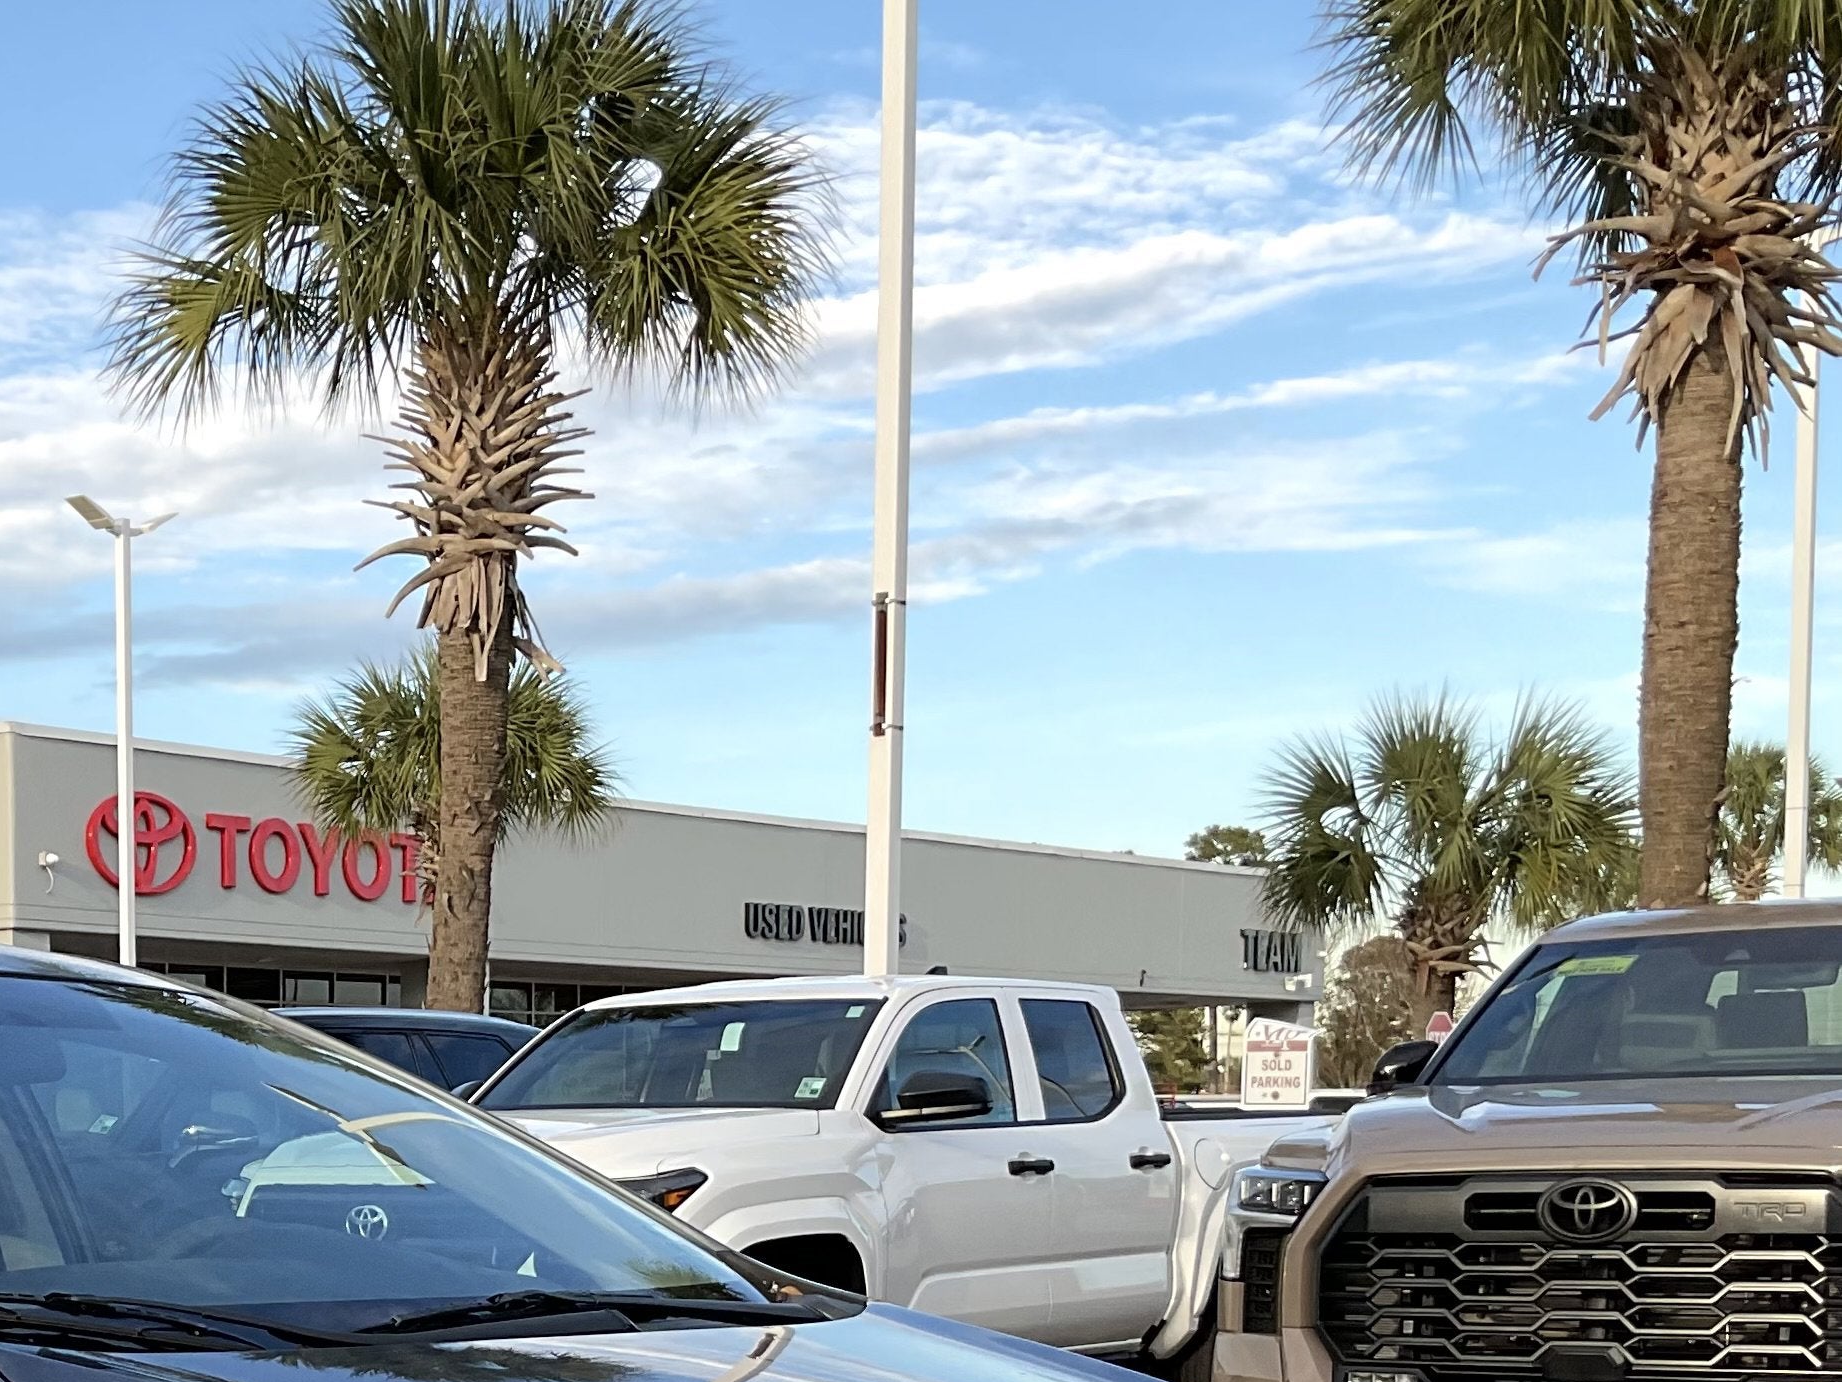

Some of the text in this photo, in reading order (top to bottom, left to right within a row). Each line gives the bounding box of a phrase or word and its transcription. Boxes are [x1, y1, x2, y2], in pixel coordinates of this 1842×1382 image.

[205, 813, 434, 905] TOYOT
[744, 902, 907, 948] USED VEHIS
[1240, 928, 1302, 972] TEAM
[1261, 1059, 1292, 1071] SOLD
[1250, 1076, 1301, 1088] PARKING
[1734, 1202, 1807, 1222] TRD
